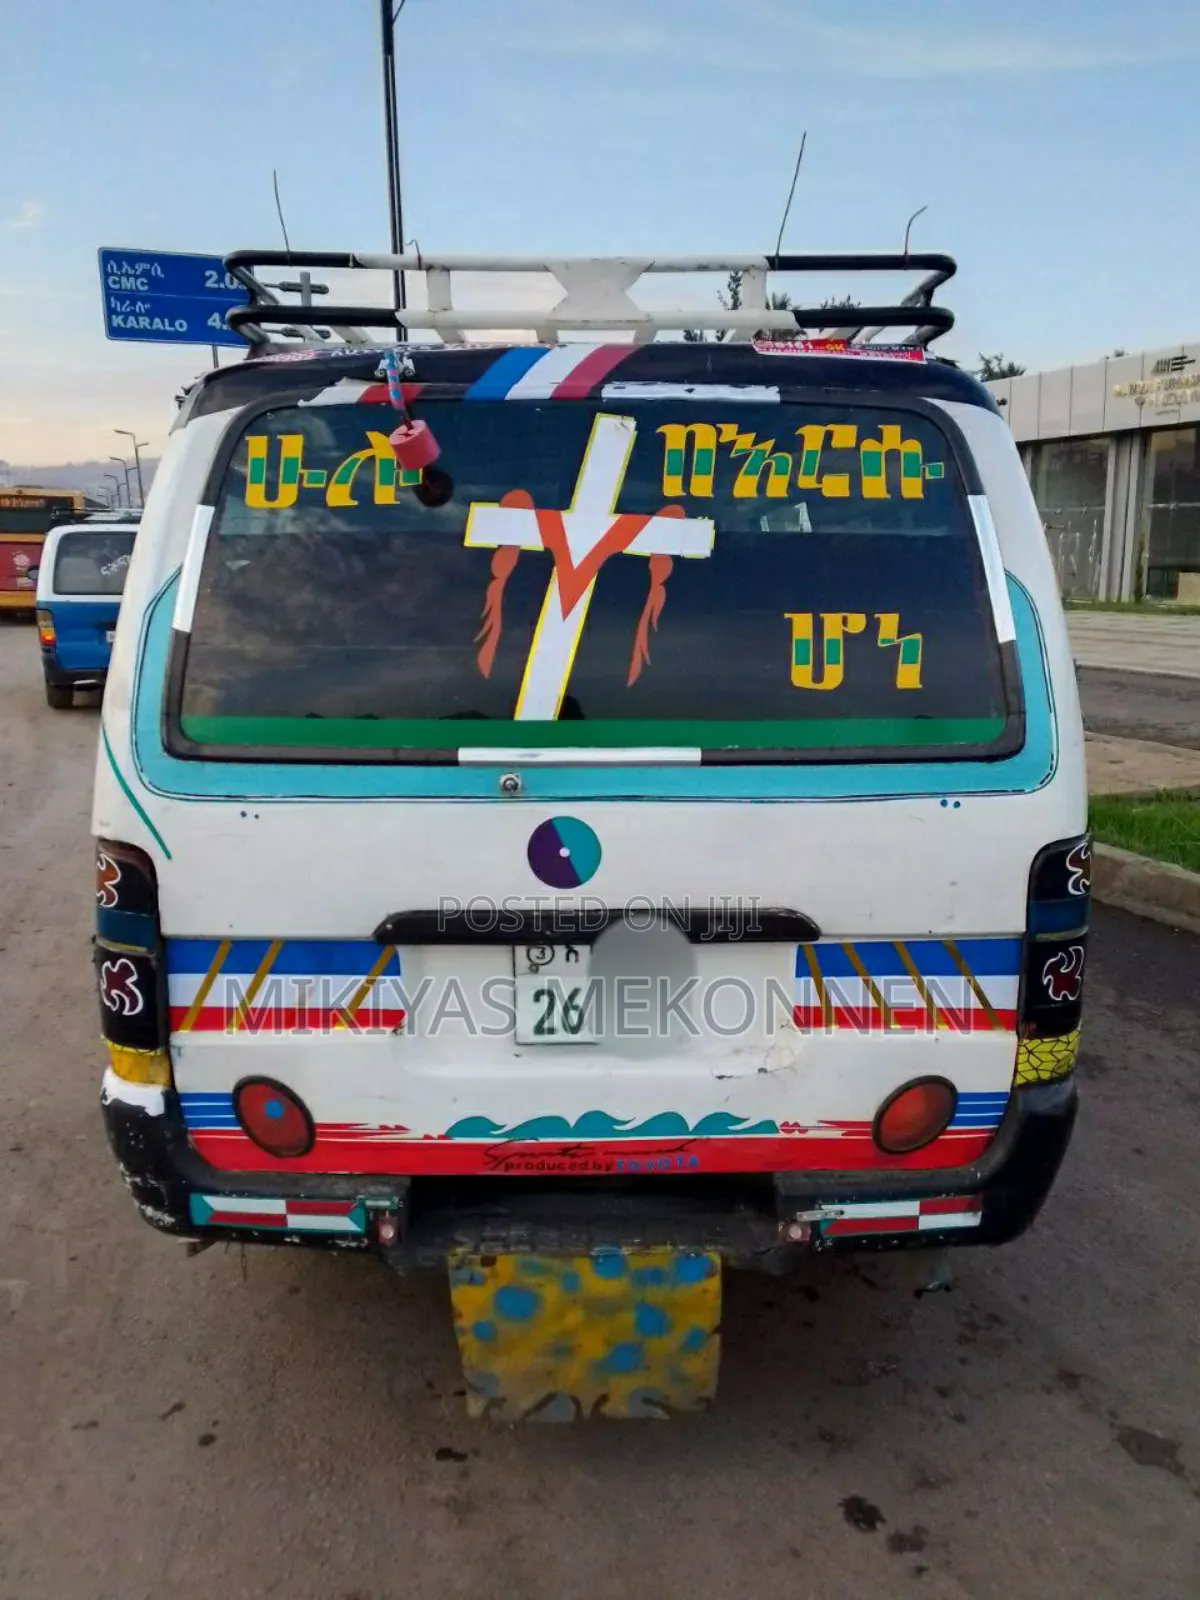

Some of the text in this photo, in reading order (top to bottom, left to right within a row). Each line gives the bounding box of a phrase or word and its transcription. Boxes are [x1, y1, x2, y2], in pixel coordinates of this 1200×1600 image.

[107, 269, 247, 290] CMC 2.0
[111, 314, 188, 332] KARALO
[245, 431, 423, 509] ሁሉ
[784, 612, 923, 690] ሆነ
[533, 987, 585, 1035] 26
[616, 1155, 699, 1171] TOYOTA
